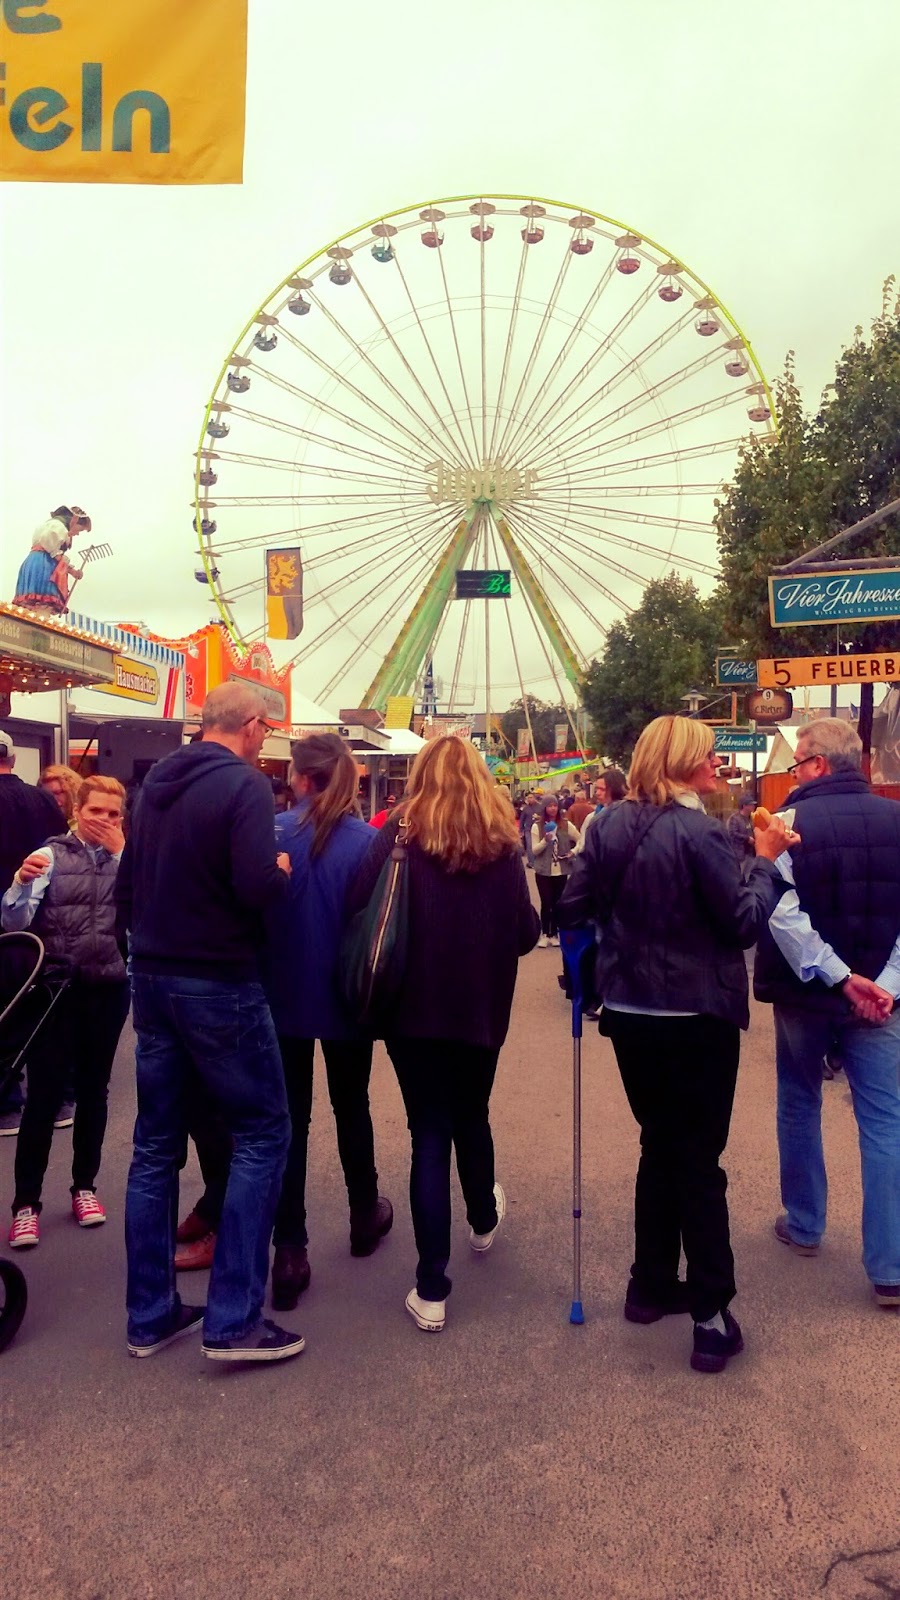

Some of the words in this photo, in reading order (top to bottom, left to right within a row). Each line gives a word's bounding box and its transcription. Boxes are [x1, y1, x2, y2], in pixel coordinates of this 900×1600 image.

[0, 62, 170, 153] eln
[777, 583, 826, 609] Vier
[774, 660, 791, 686] 5
[812, 658, 900, 679] FEUERB
